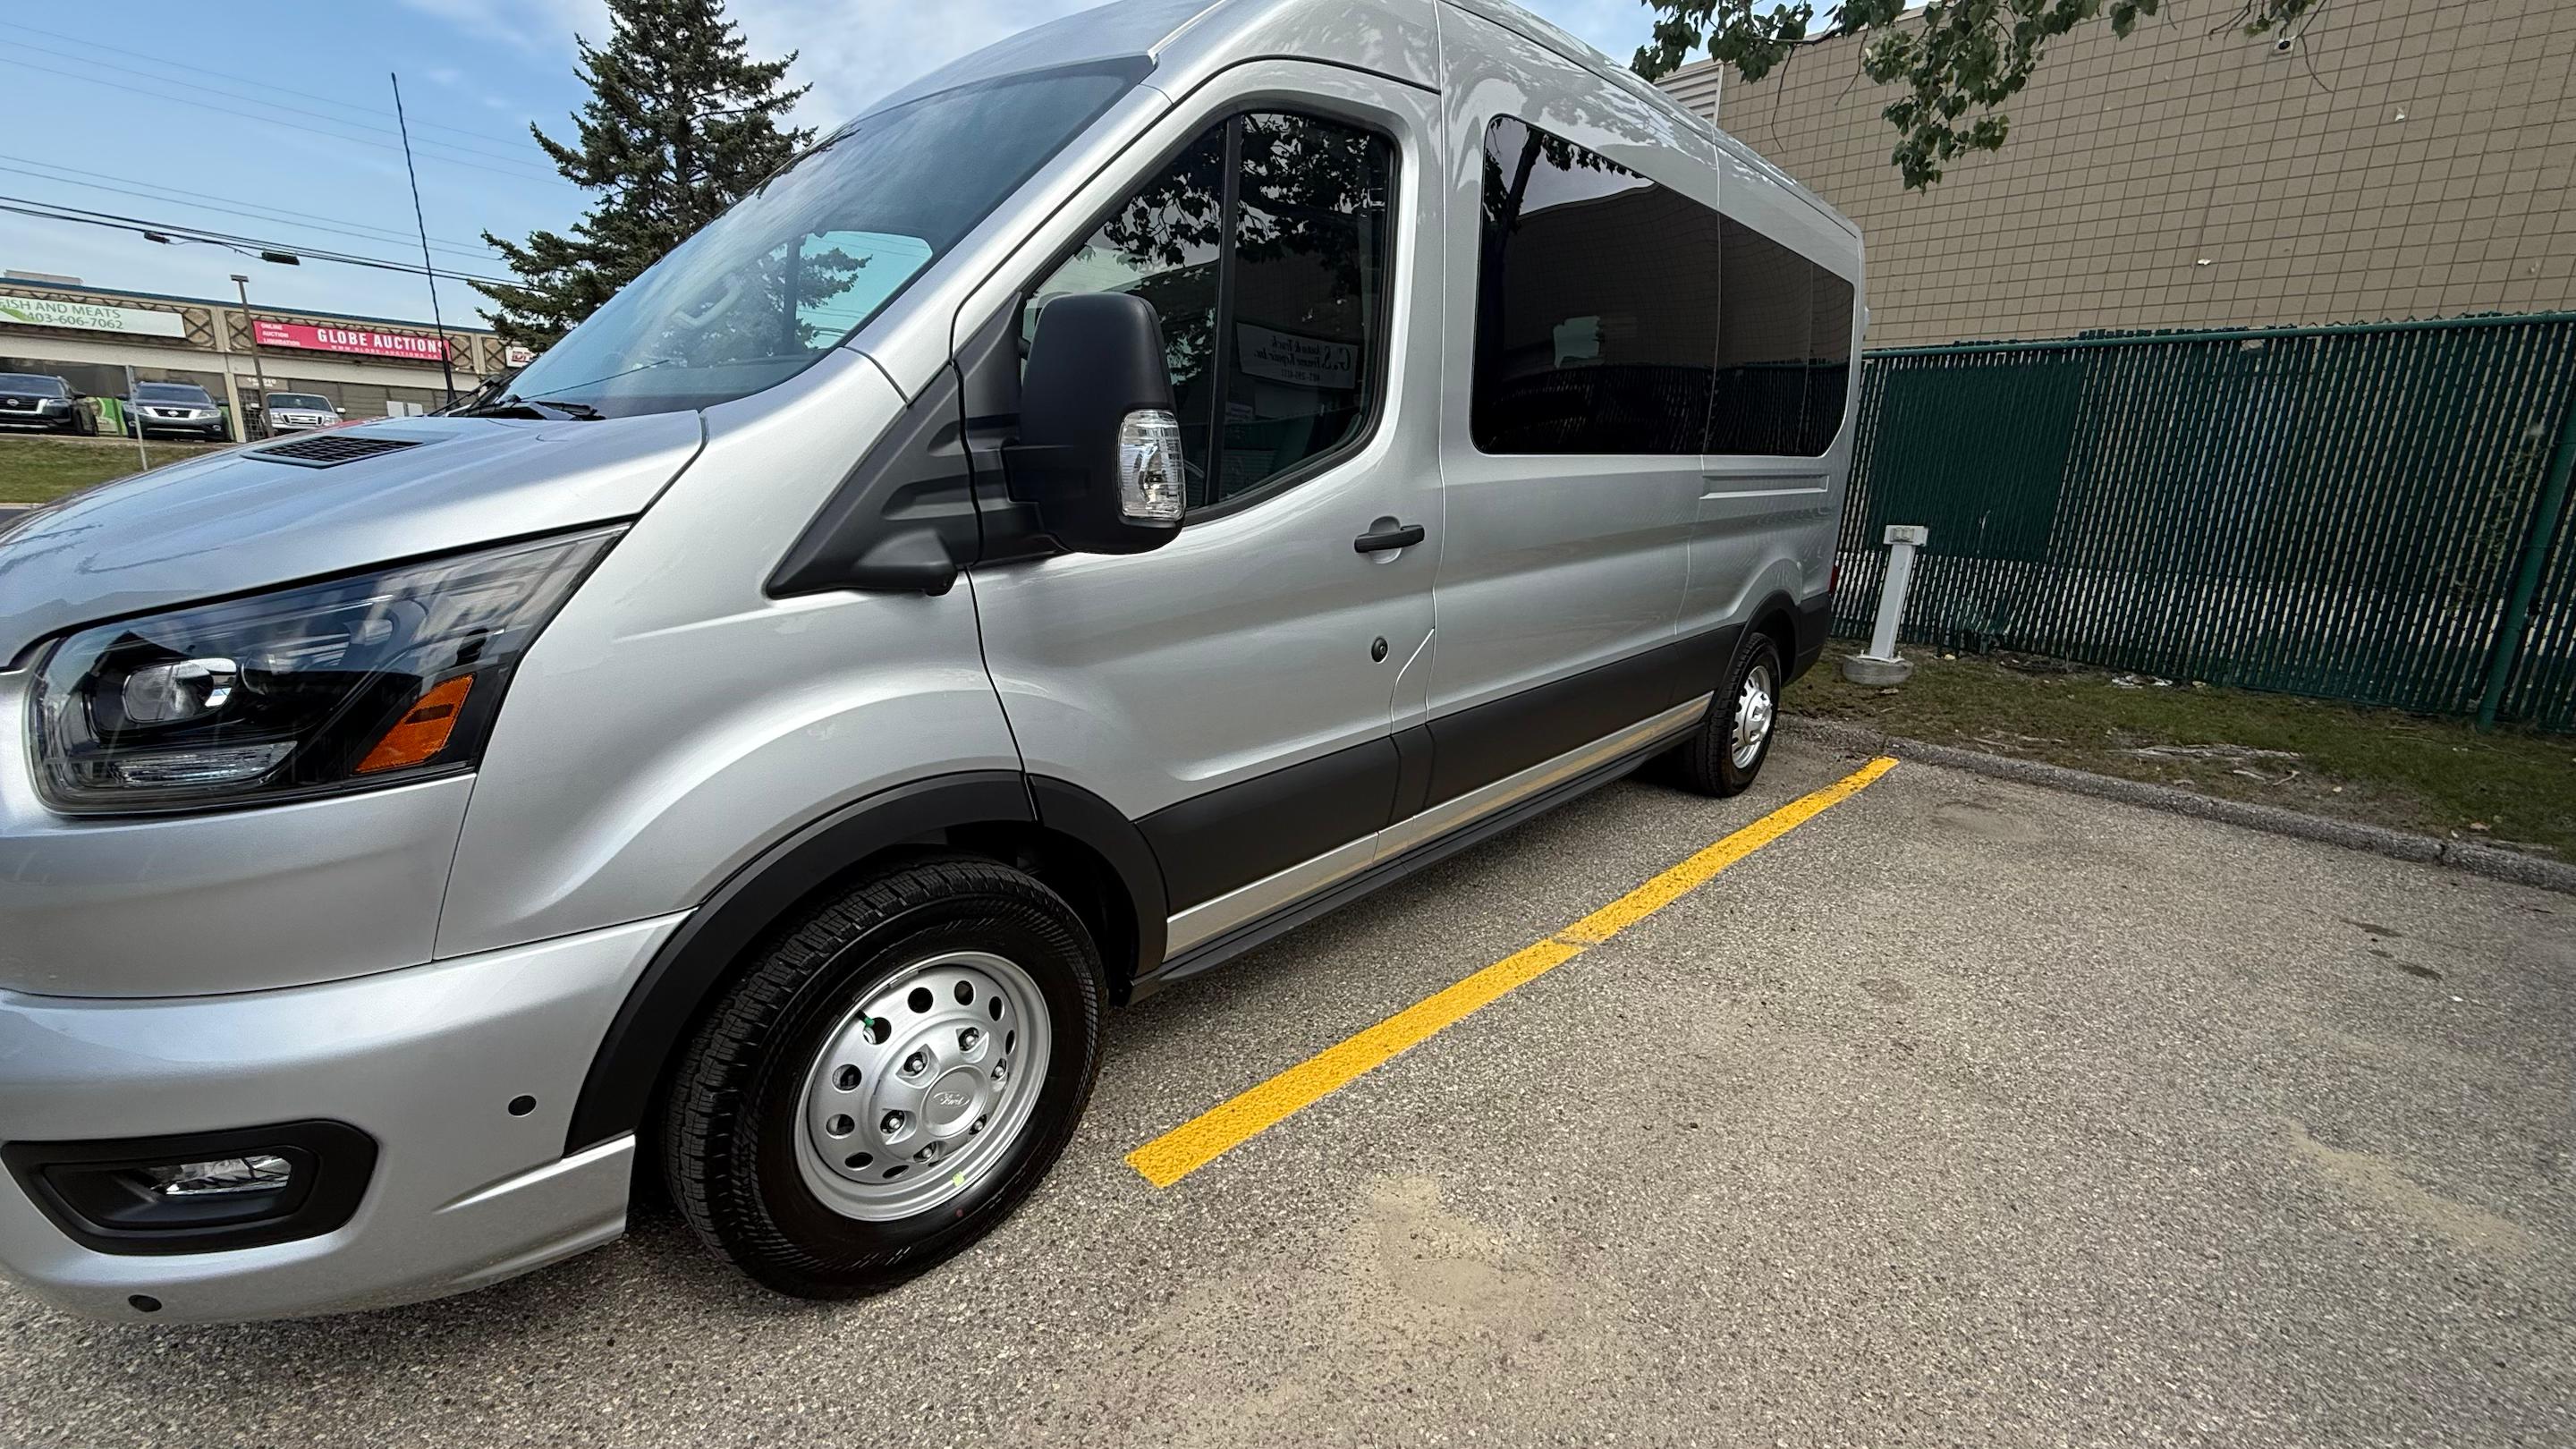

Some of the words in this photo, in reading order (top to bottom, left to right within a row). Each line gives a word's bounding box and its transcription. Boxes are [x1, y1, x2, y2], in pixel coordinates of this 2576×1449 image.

[36, 301, 68, 314] AND
[72, 305, 121, 319] MEATS
[27, 311, 123, 330] 403-606-7062
[262, 330, 289, 338] AUCTION
[317, 328, 368, 346] GLOBE
